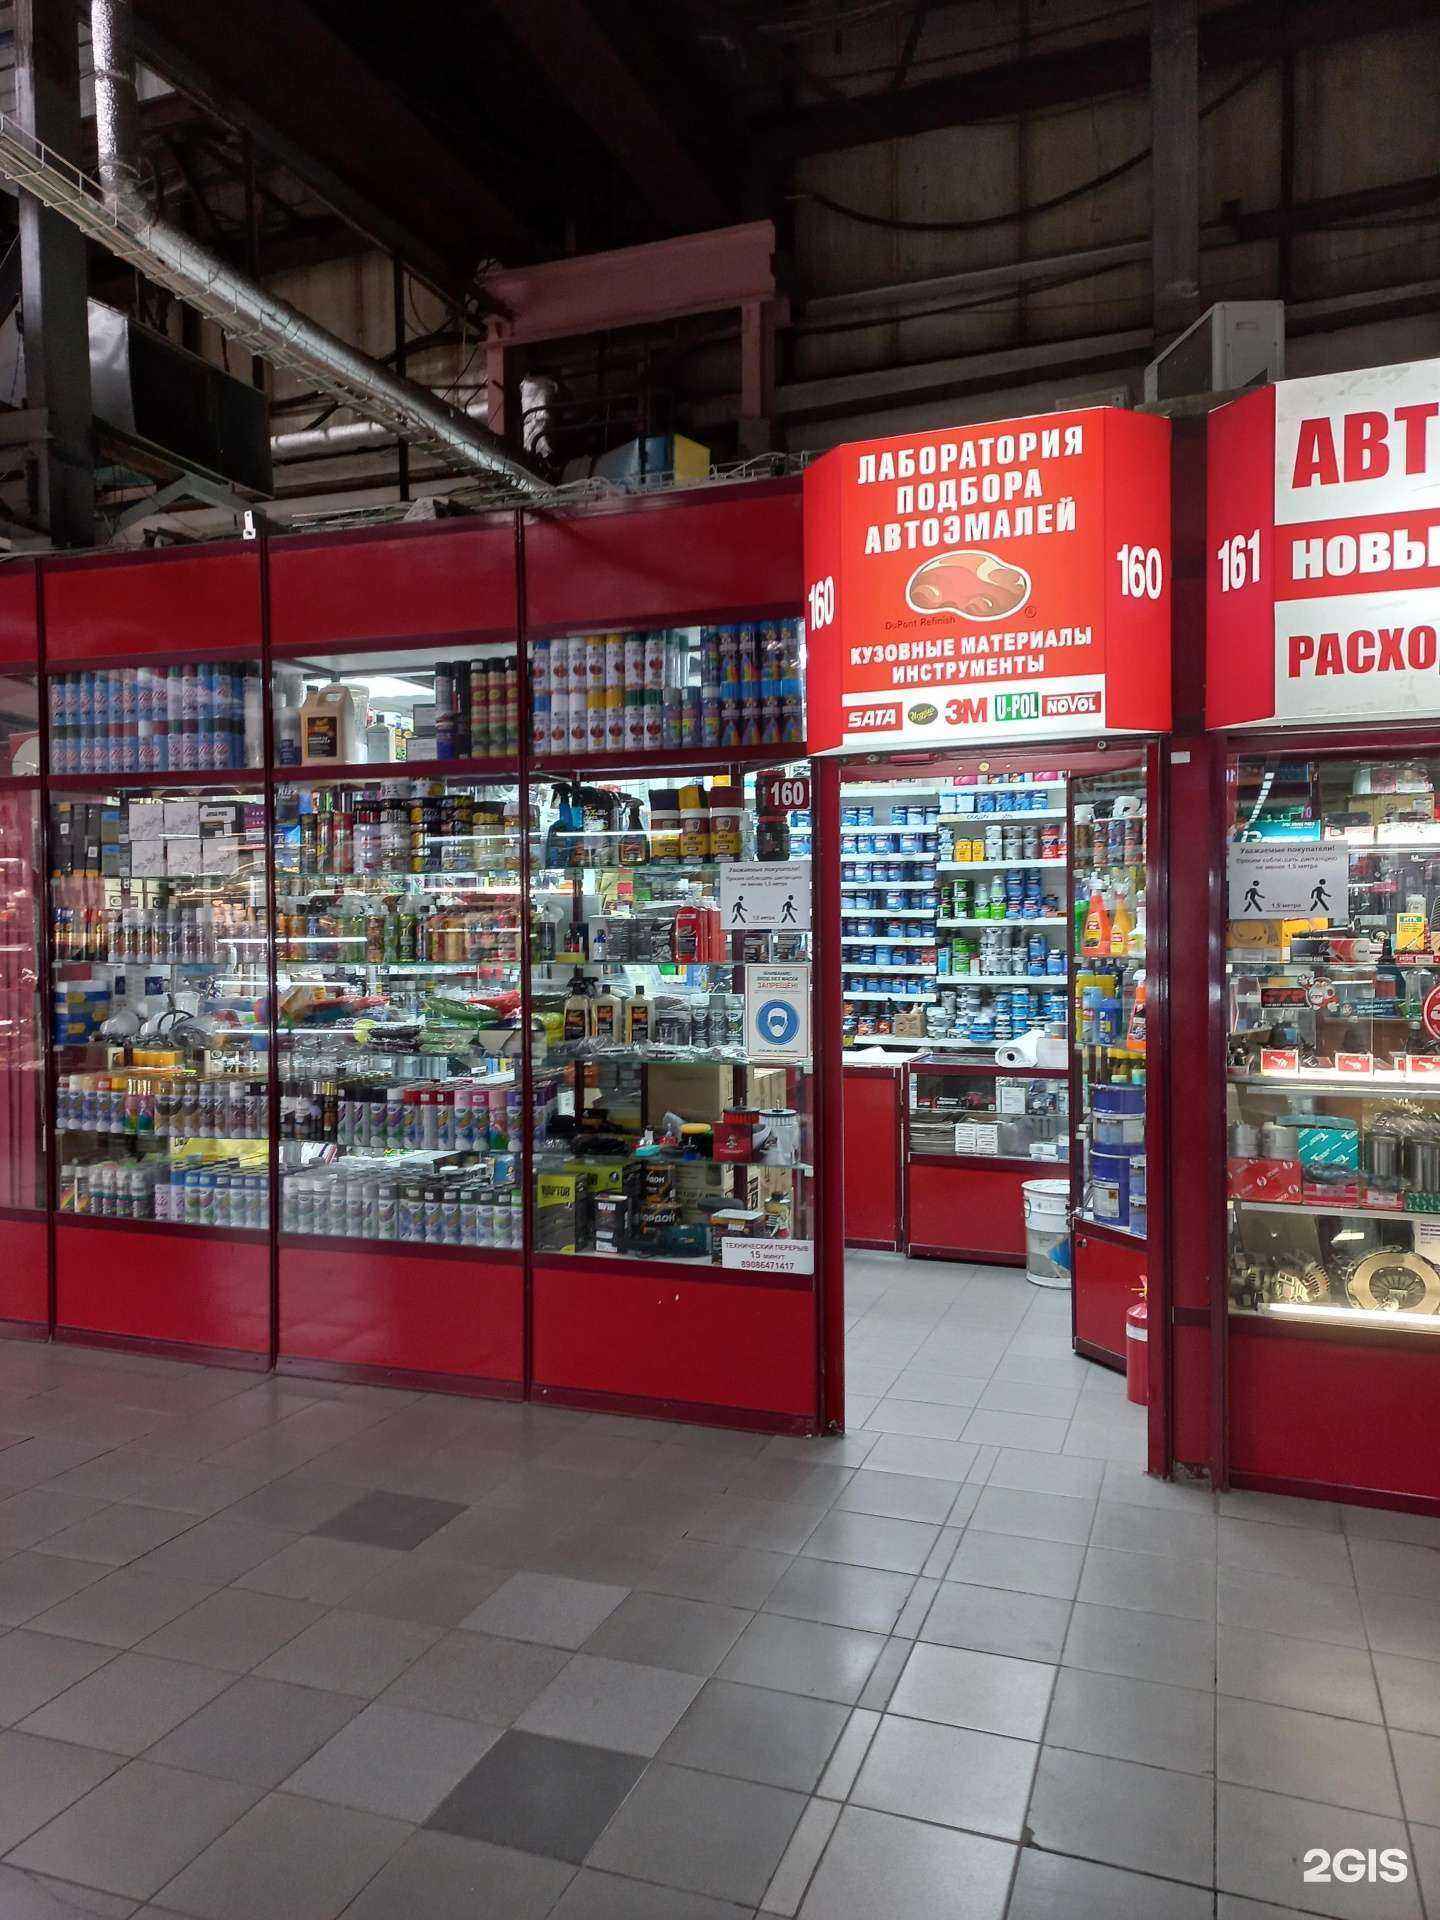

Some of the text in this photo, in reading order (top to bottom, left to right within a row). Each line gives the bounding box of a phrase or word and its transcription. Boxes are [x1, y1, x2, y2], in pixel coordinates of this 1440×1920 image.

[857, 425, 1084, 485] ЛАБОРАТОРИЯ
[896, 468, 1043, 514] ПОДБОРА
[864, 496, 1077, 555] АВТОЭМАЛЕЙ
[1116, 543, 1163, 600] 160
[1217, 528, 1261, 593] 161
[808, 575, 835, 632] 160
[850, 625, 1093, 666] КУЗОВНЫЕ МАТЕРИАЛЫ
[892, 654, 1045, 684] ИНСТРУМЕНТЫ
[1287, 624, 1440, 678] РАСХО
[848, 708, 896, 728] SATA
[945, 698, 988, 725] 3M
[1046, 695, 1096, 713] NOVOL
[770, 781, 805, 806] 160
[750, 1250, 761, 1259] 15
